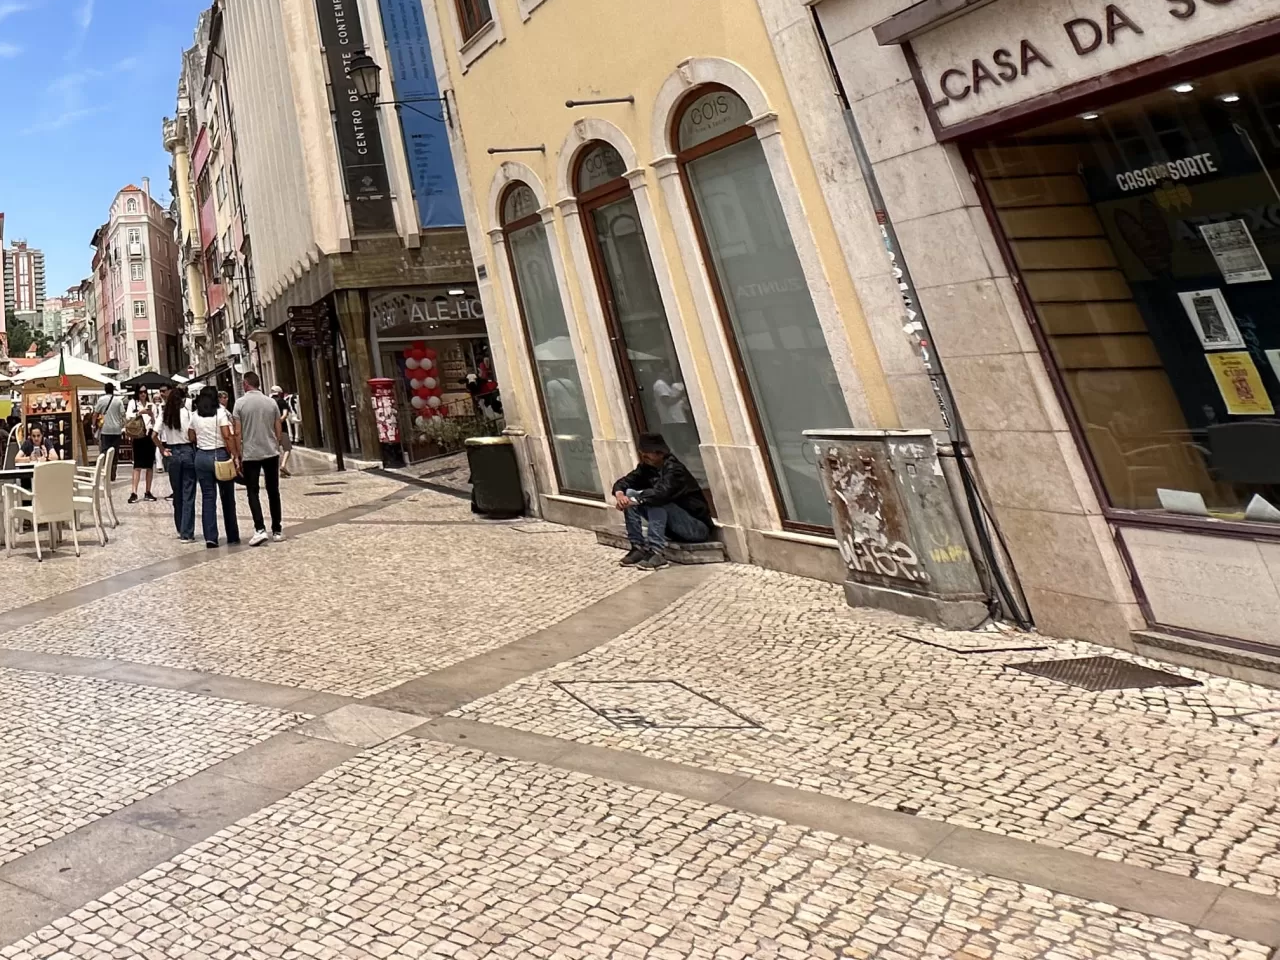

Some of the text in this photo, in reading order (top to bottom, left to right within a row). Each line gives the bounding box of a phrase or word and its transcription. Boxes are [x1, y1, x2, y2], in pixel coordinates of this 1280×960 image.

[939, 39, 1053, 100] CASA
[1063, 3, 1144, 56] DA
[348, 88, 359, 102] DE
[352, 109, 369, 155] CENTRO
[1116, 166, 1156, 191] CASA
[1166, 152, 1218, 181] SORTE
